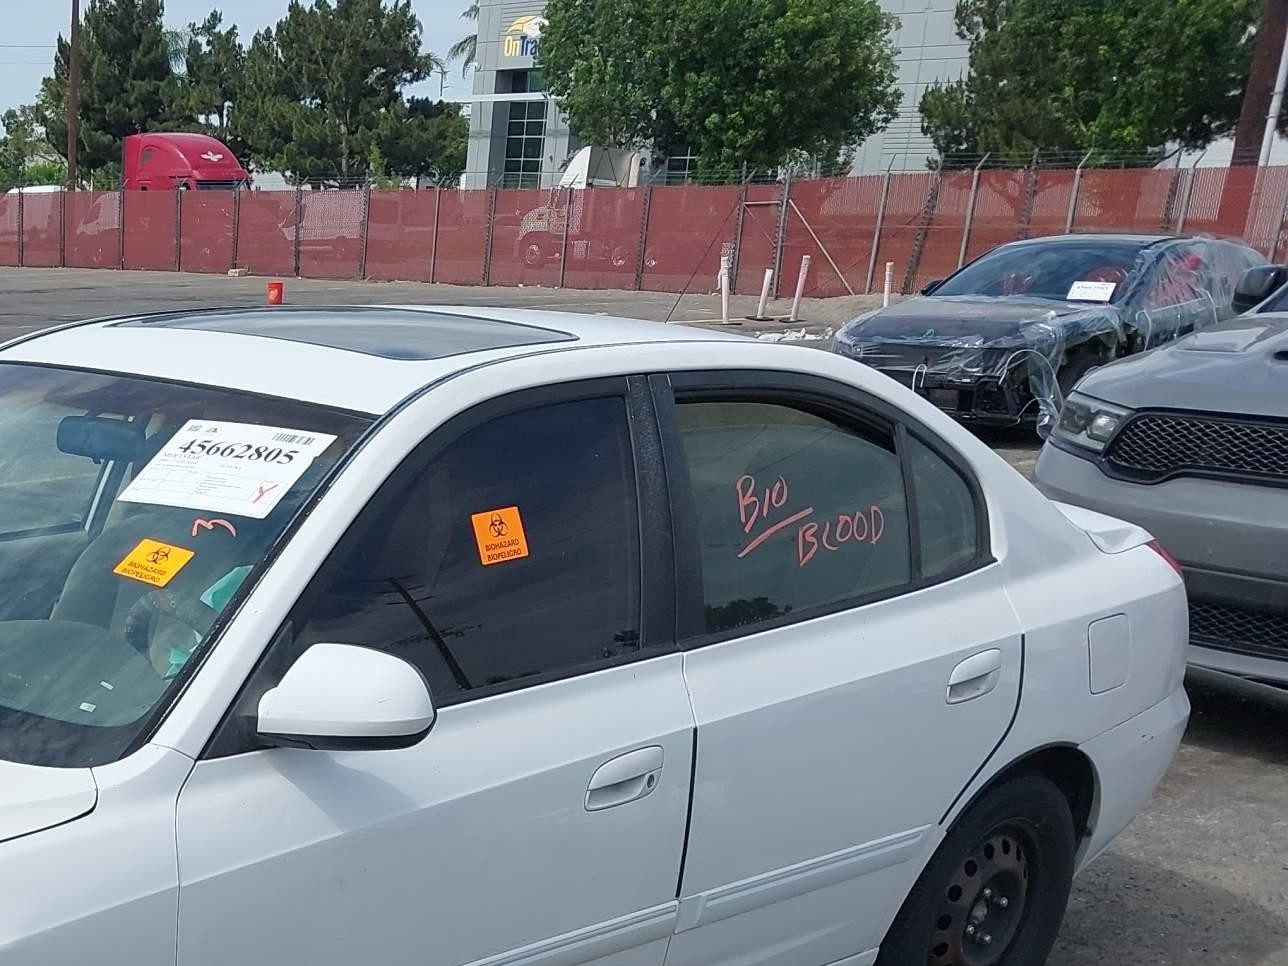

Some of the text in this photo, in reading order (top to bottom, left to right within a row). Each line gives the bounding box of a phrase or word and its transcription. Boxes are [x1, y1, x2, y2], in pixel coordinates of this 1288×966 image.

[179, 438, 301, 464] 45662805
[798, 504, 885, 567] BLOOD
[485, 539, 520, 551] BIOHAZARD
[487, 549, 522, 562] BIOPELIGRO
[121, 568, 160, 583] BIOPELIGRO
[128, 561, 167, 576] BIOHAZARD
